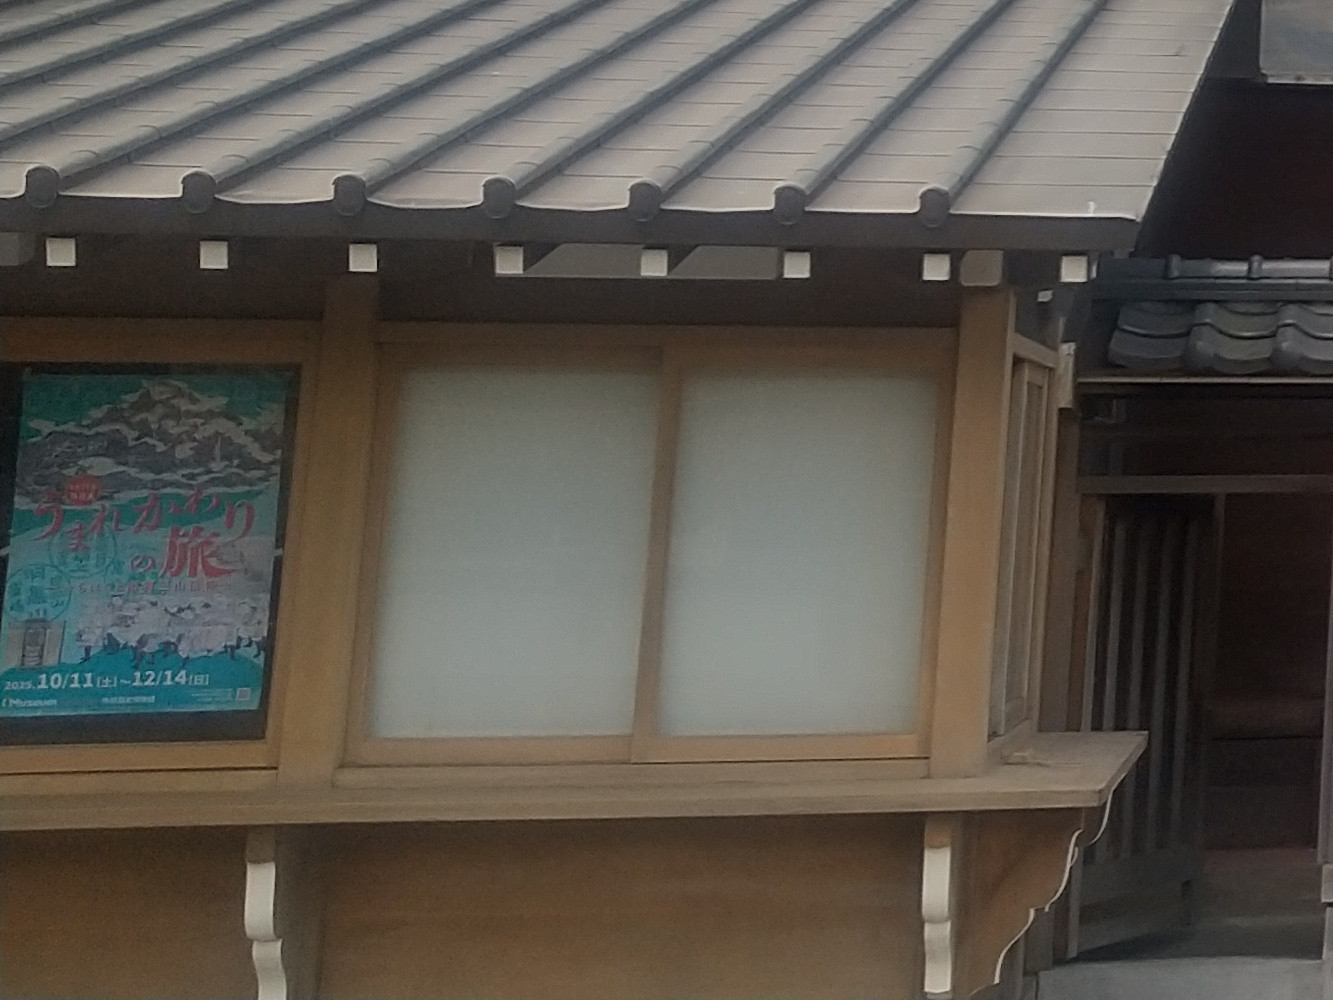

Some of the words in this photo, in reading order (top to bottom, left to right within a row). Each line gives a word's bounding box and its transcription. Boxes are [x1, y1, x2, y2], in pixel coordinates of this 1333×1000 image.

[33, 490, 254, 550] うまれかわり
[130, 525, 238, 578] の旅
